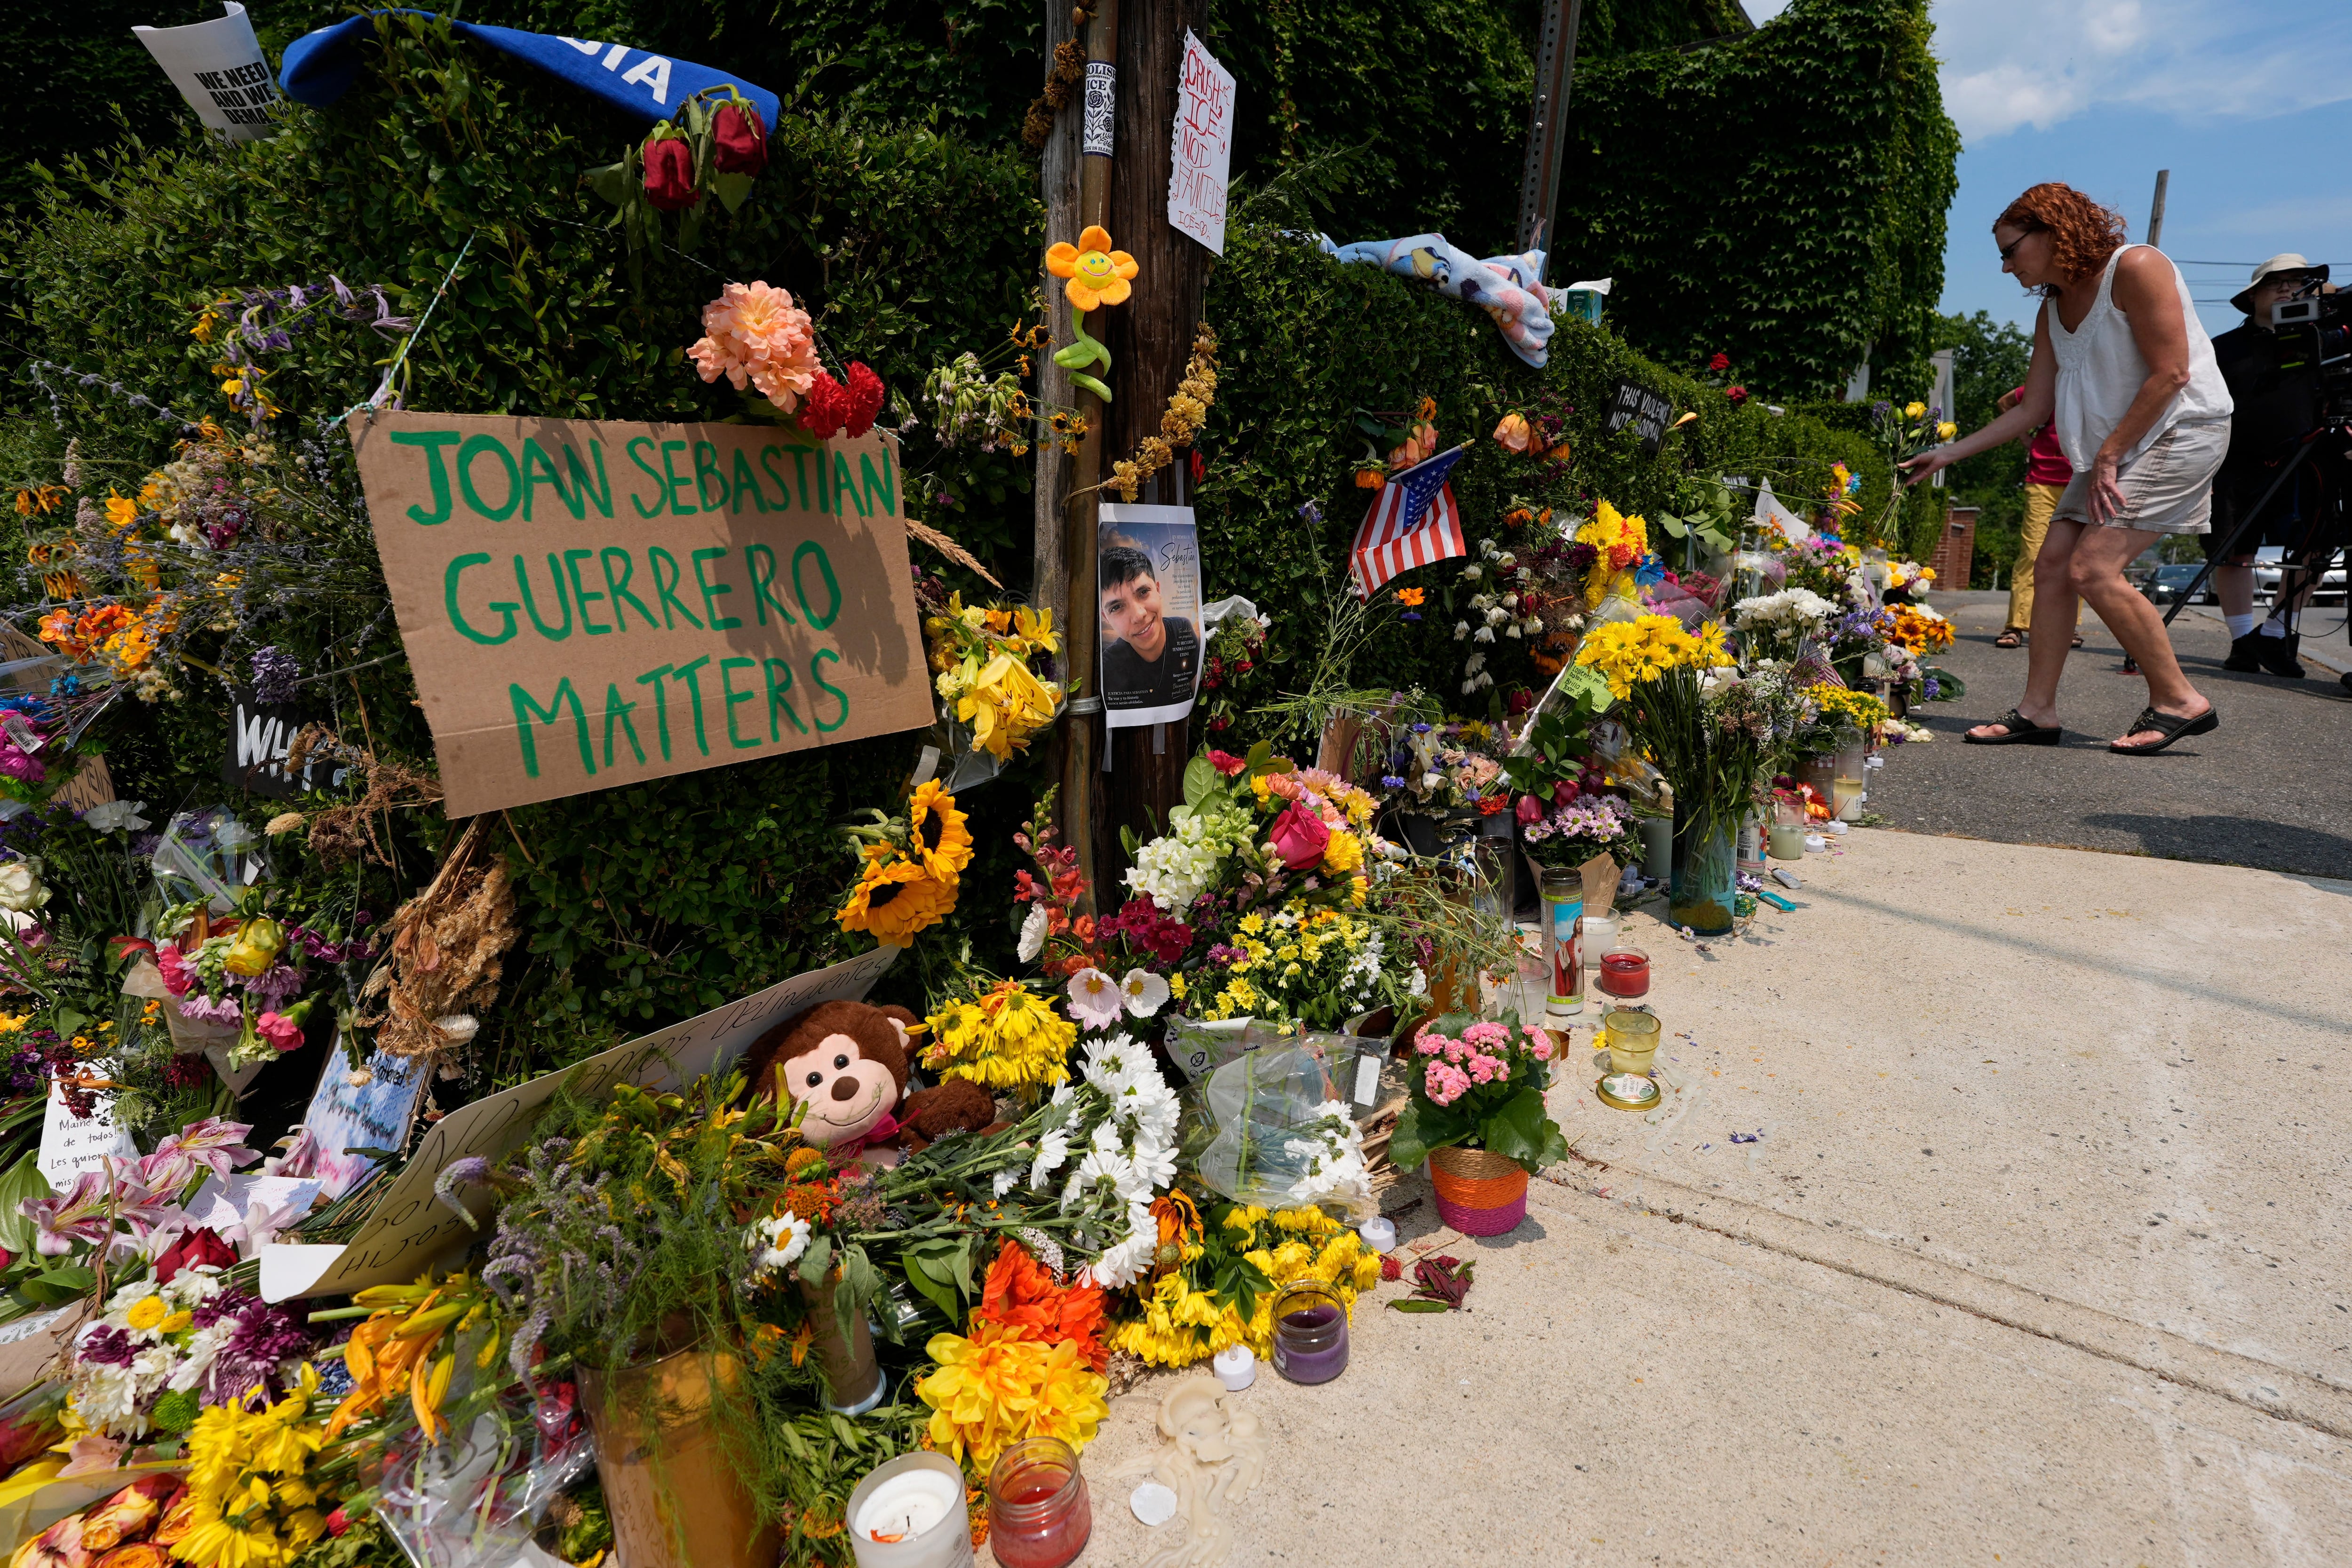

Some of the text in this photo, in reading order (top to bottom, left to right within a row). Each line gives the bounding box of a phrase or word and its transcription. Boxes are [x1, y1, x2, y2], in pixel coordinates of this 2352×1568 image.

[193, 62, 268, 89] WE NEED
[556, 36, 672, 105] IA
[1185, 49, 1220, 110] CRUSH
[209, 82, 276, 107] AND WE
[1087, 79, 1106, 90] ICE
[222, 101, 289, 125] DEMA
[1184, 91, 1222, 138] ICE
[1182, 127, 1208, 167] NOT
[1618, 385, 1641, 408] THIS
[1609, 411, 1632, 431] NOT
[390, 430, 895, 525] JOAN SEBASTIAN
[445, 540, 842, 646] GUERRERO
[1563, 684, 1575, 693] Joan
[1564, 678, 1580, 689] Brilla
[509, 648, 849, 778] MATTERS
[64, 1138, 76, 1148] de
[400, 1098, 519, 1195] NO
[51, 1158, 67, 1170] Les
[56, 1178, 72, 1188] mis
[225, 1189, 259, 1198] DEAR
